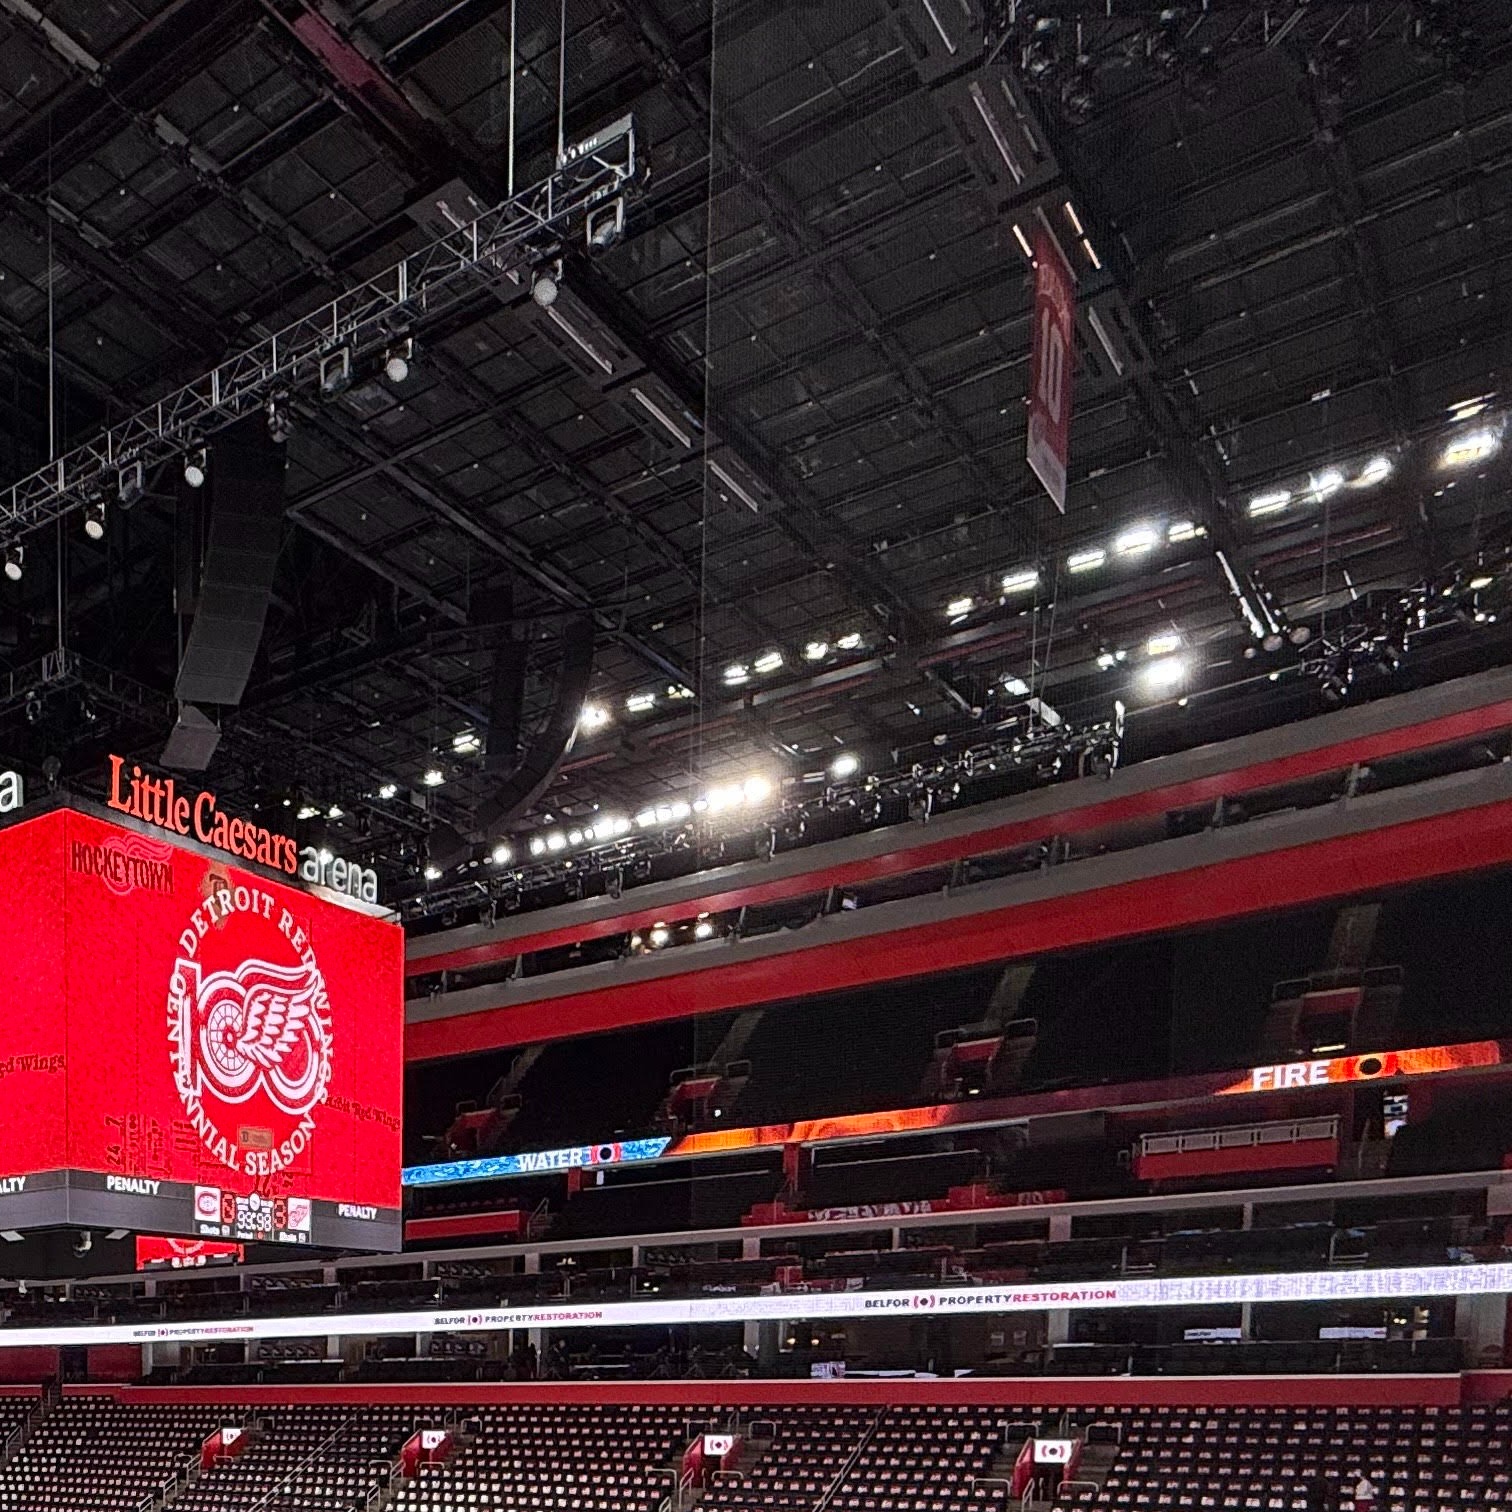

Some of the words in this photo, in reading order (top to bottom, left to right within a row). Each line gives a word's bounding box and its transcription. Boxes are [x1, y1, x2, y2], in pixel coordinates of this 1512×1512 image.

[107, 753, 190, 835] Little
[194, 791, 298, 874] Caesars
[299, 845, 378, 904] arena
[71, 841, 175, 894] HOCKEYTOWN
[179, 886, 274, 957] DETROIT
[278, 908, 316, 970] RED
[1253, 1061, 1331, 1092] FIRE
[245, 1113, 316, 1176] SEASON
[517, 1149, 583, 1171] WATER
[107, 1175, 159, 1195] PENALTY
[338, 1204, 377, 1220] PENALTY
[865, 1298, 910, 1308] BELFOR
